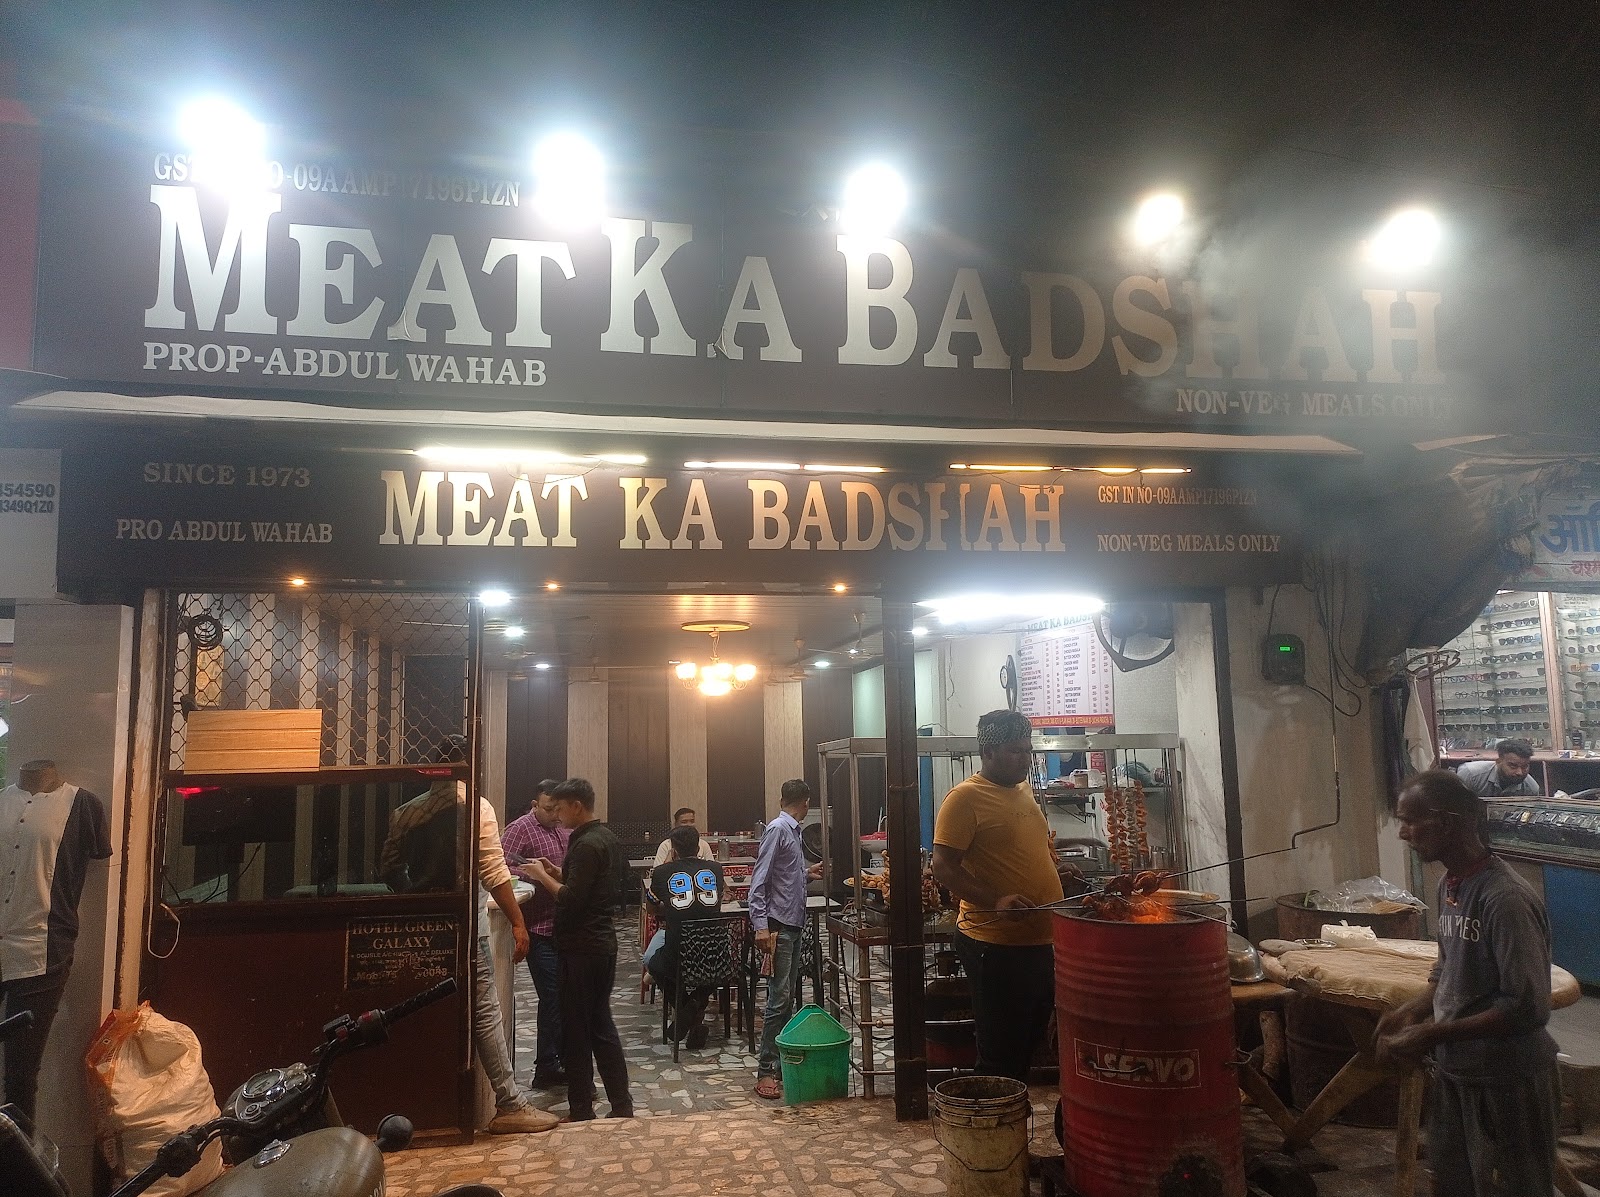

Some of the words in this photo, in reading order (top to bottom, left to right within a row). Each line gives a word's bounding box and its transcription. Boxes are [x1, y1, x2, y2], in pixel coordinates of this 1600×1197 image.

[144, 183, 578, 348] MEAT
[600, 216, 803, 363] KA
[837, 234, 1443, 384] BADSHAH
[143, 341, 400, 381] PROP-ABDUL
[406, 353, 547, 386] WAHAB
[1176, 388, 1291, 416] NON-VEG
[1302, 391, 1386, 418] MEALS
[143, 462, 236, 486] SINCE
[246, 466, 311, 488] 1973
[0, 483, 56, 498] 54590
[1098, 484, 1120, 504] GST
[1122, 485, 1135, 504] IN
[379, 470, 589, 548] MEAT
[619, 477, 723, 550] KA
[747, 478, 1066, 552] BADSHAH
[116, 518, 163, 541] PRO
[168, 520, 247, 543] ABDUL
[251, 521, 333, 544] WAHAB
[1097, 534, 1173, 552] NON-VEG
[1177, 534, 1235, 552] MEALS
[1238, 534, 1281, 552] ONLY
[1049, 615, 1062, 629] KA
[667, 868, 719, 910] 99
[351, 922, 403, 935] HOTEL
[405, 920, 454, 933] GREEN
[372, 936, 433, 950] GALAXY
[1103, 1052, 1195, 1082] SERVO
